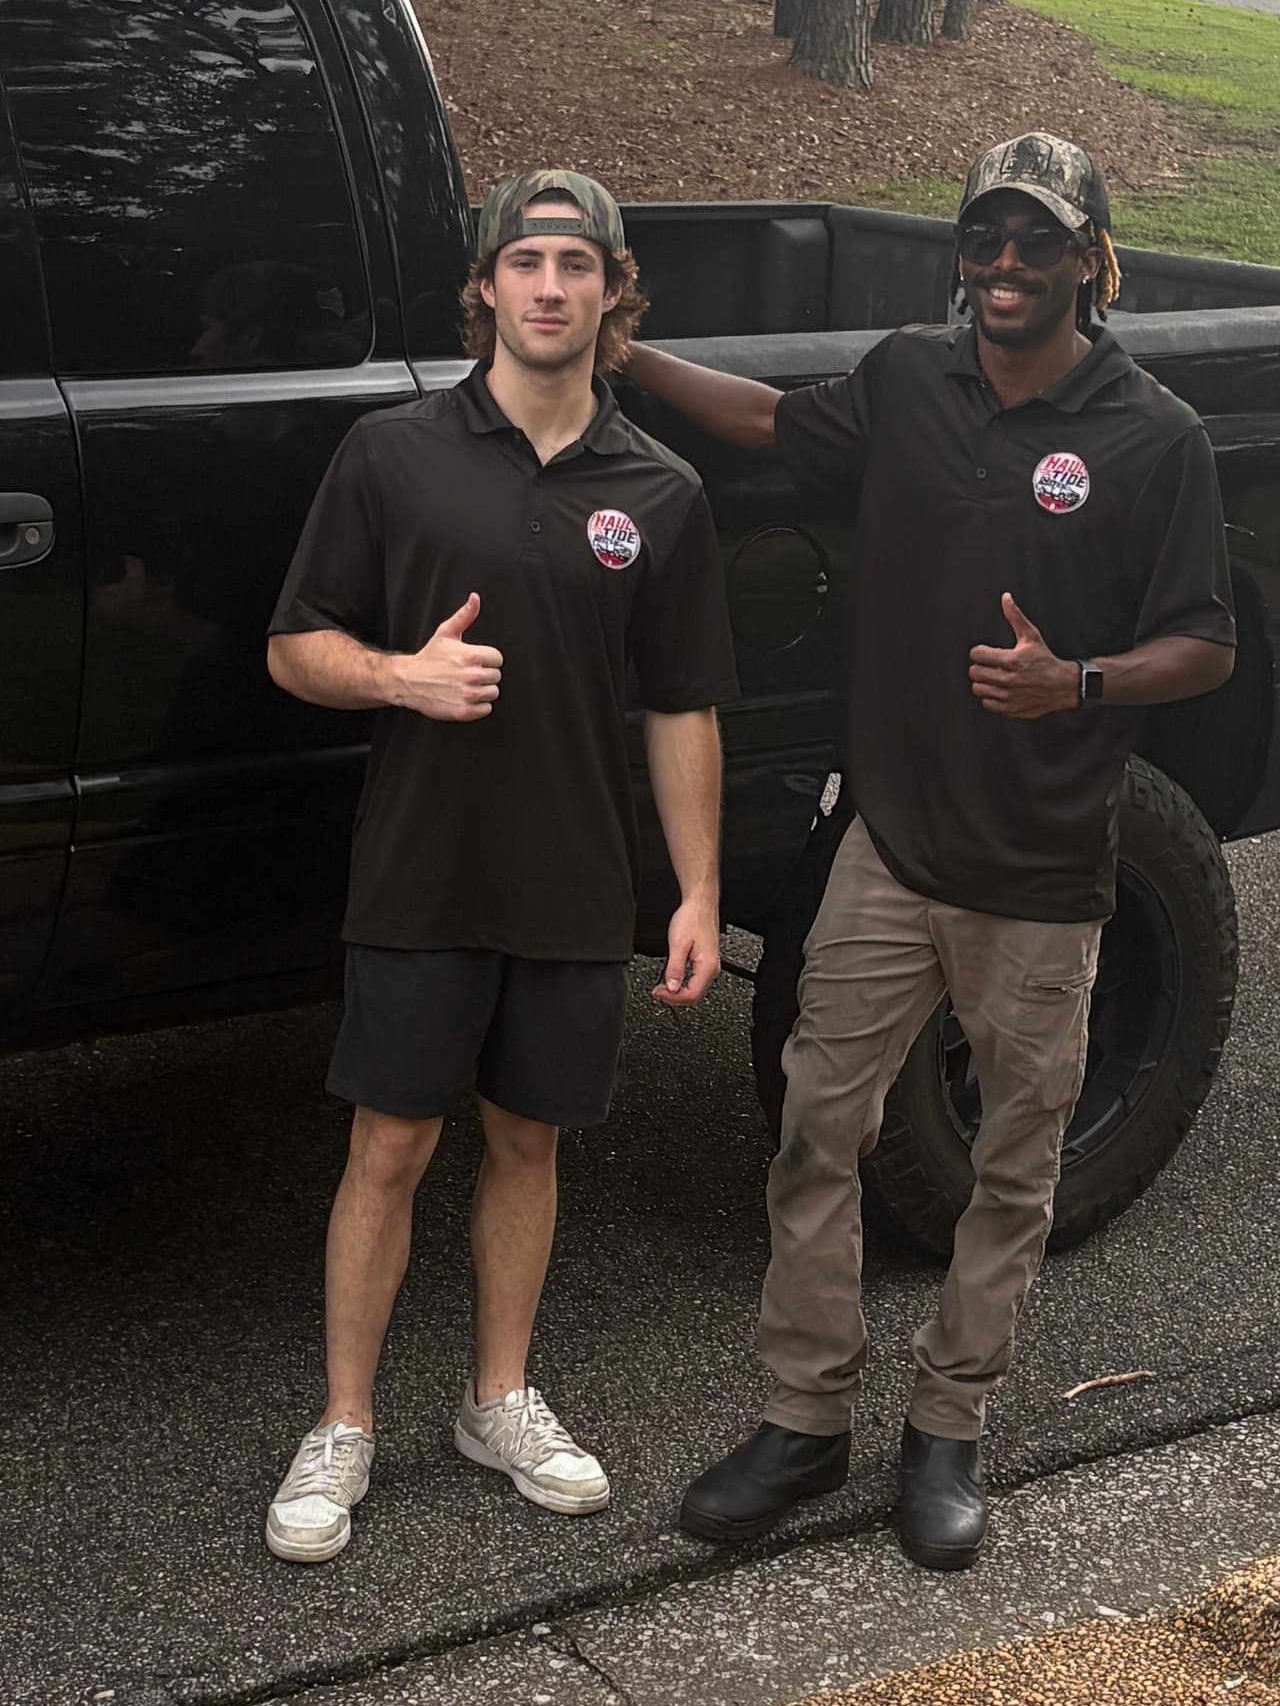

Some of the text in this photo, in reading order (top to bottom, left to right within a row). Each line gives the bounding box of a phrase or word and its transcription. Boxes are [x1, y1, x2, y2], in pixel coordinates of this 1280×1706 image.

[1045, 456, 1086, 476] HAUL
[1052, 469, 1087, 489] TIDE
[594, 514, 632, 532] HAUL
[602, 526, 638, 545] TIDE
